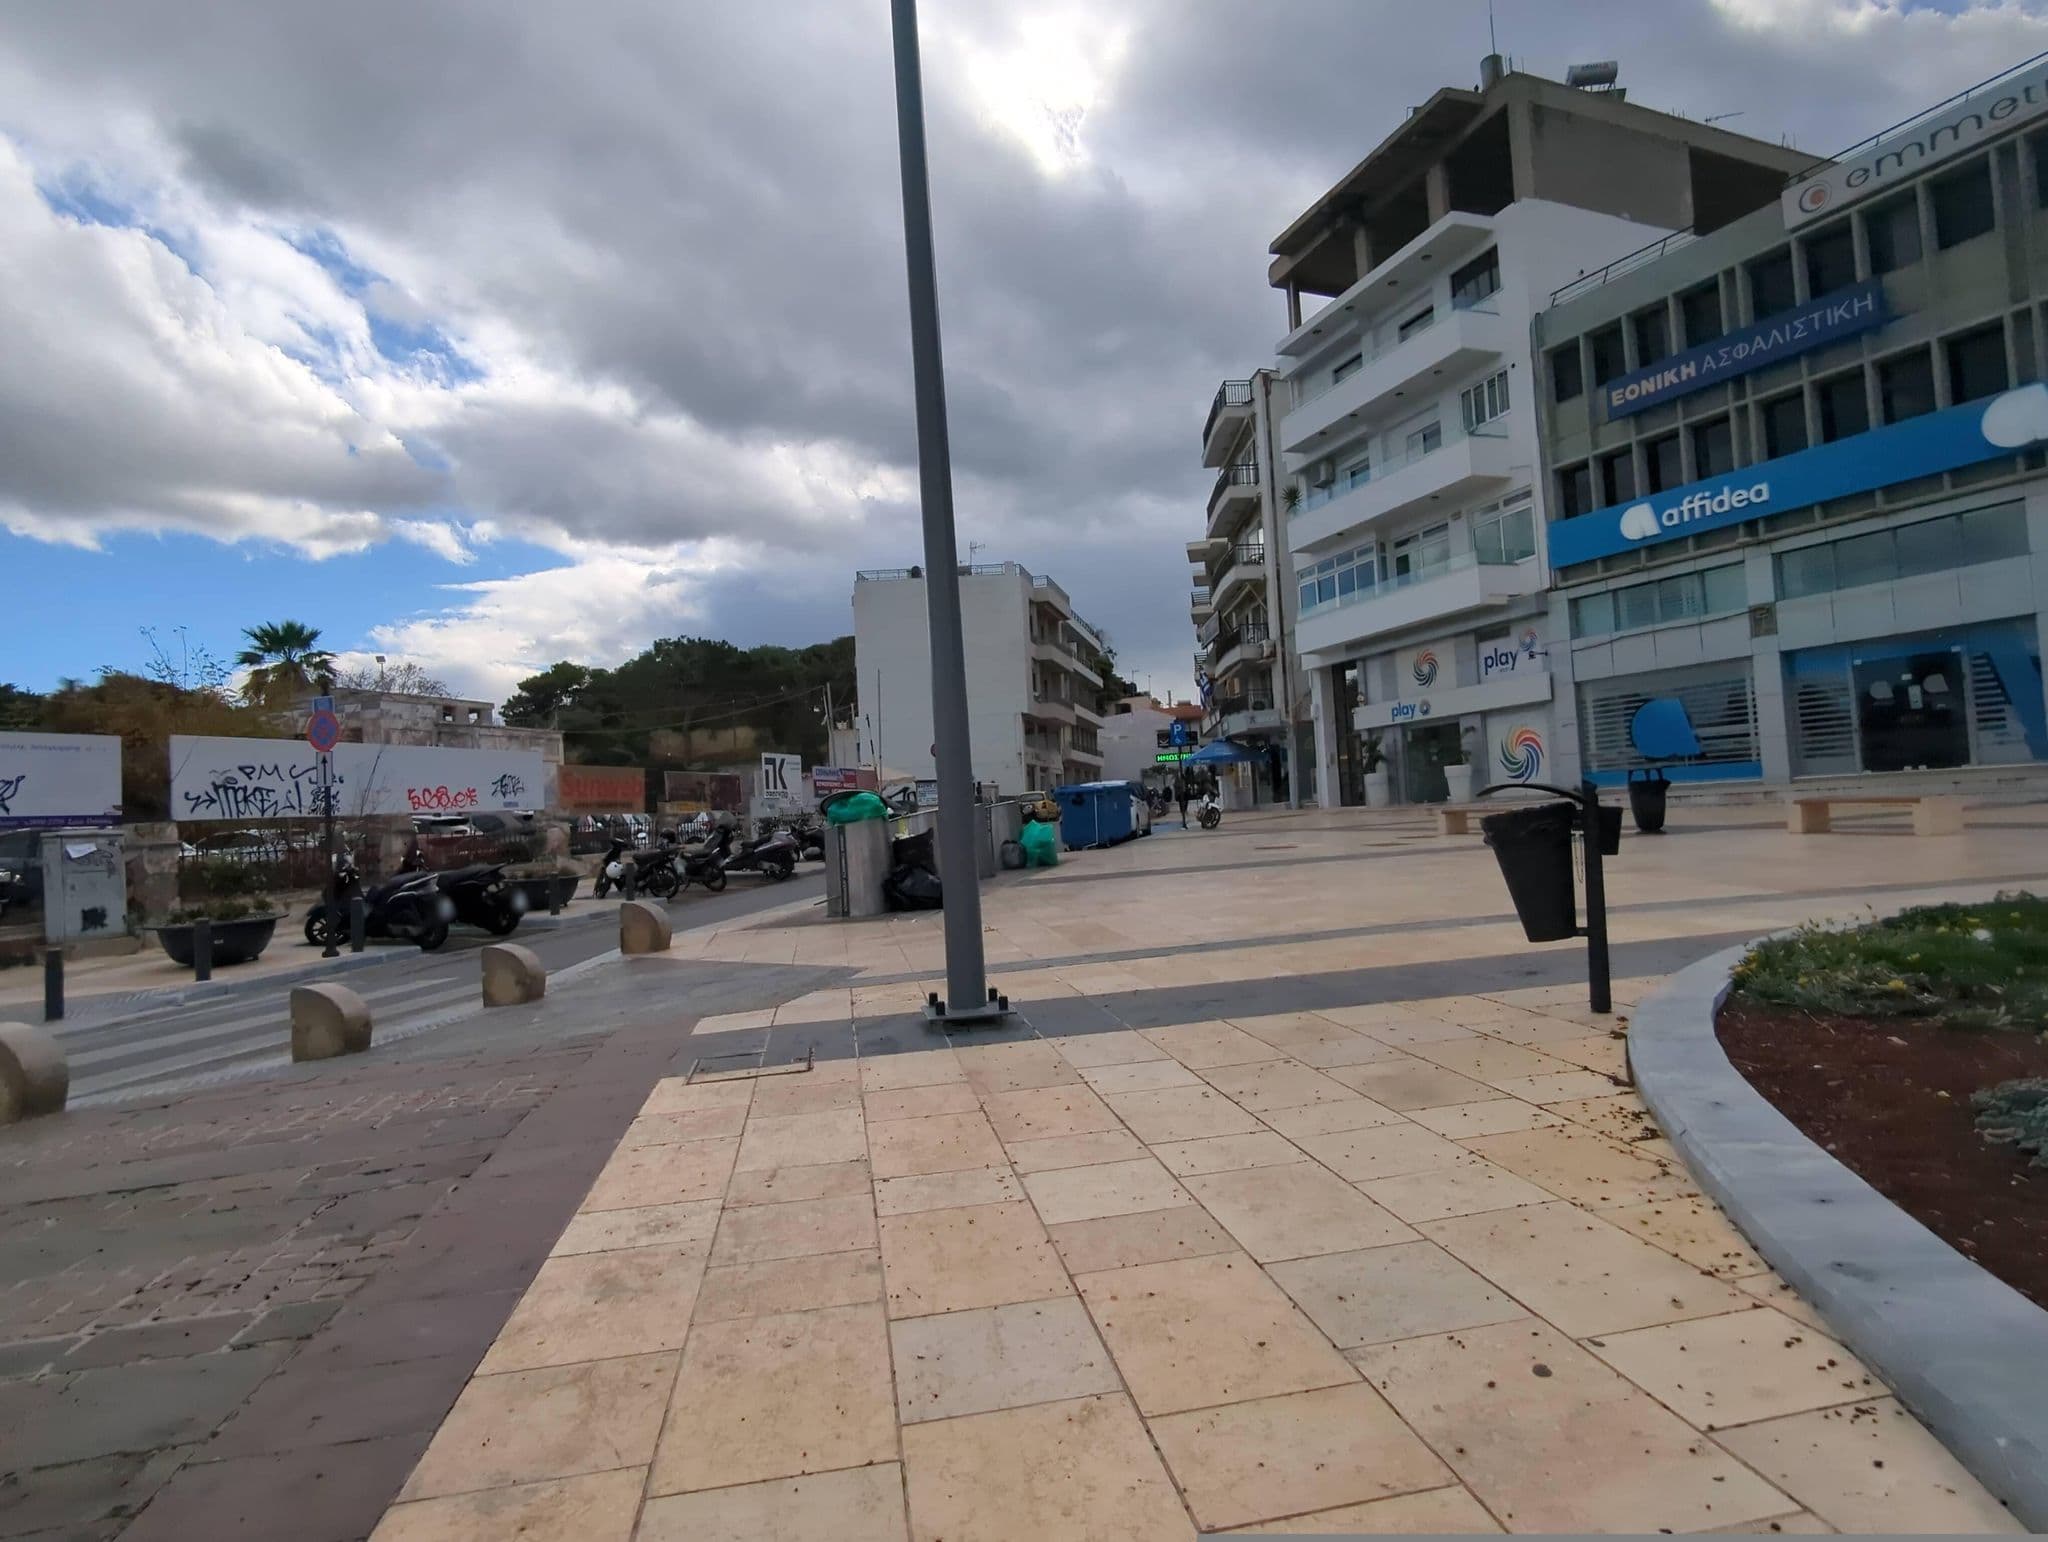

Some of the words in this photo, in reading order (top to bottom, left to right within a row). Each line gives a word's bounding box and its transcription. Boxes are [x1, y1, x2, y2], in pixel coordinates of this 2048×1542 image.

[1701, 291, 1874, 375] ΑΣΦΑΛΙΣΤΙΚΗ
[1661, 481, 1771, 527] affidea
[1484, 648, 1518, 676] play
[1390, 701, 1416, 722] play
[1173, 724, 1182, 736] P
